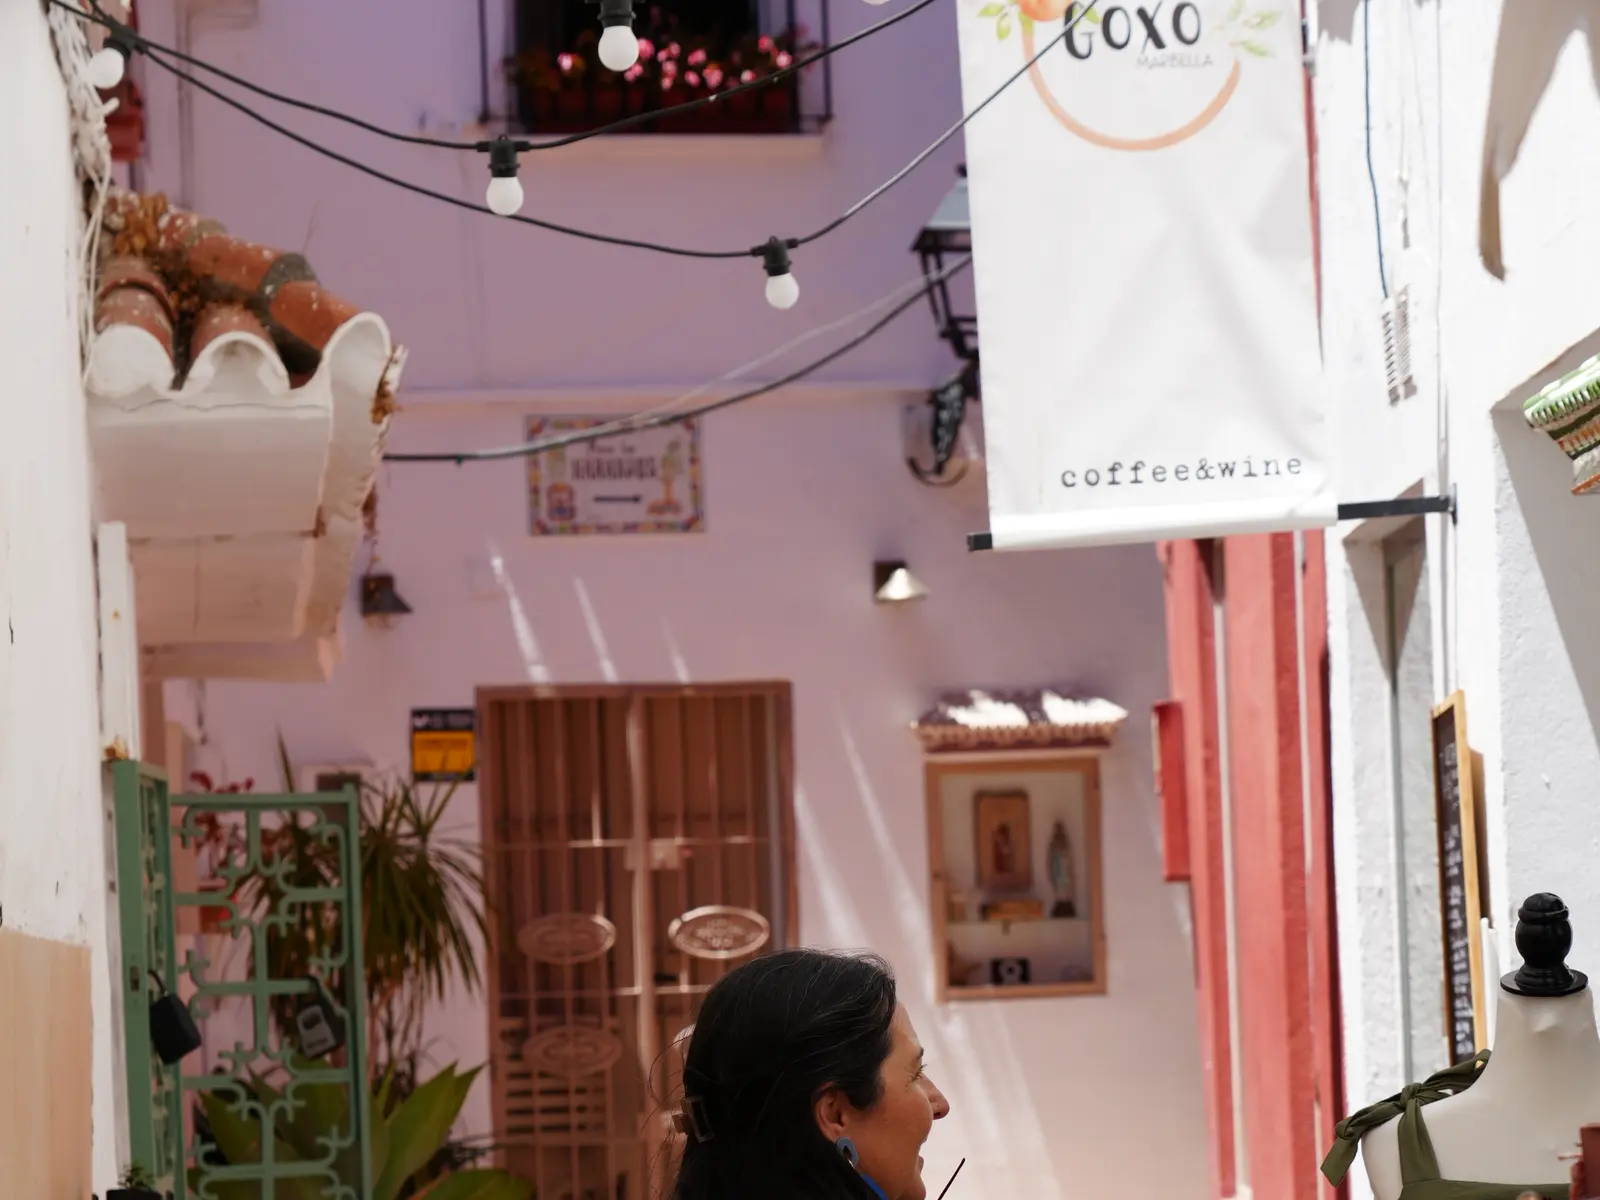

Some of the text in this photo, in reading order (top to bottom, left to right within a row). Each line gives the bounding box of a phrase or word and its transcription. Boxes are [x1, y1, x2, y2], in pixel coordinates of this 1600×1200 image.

[1063, 0, 1202, 60] GOXO
[1136, 52, 1214, 70] MARBELLA
[1061, 455, 1303, 488] coffee&wine
